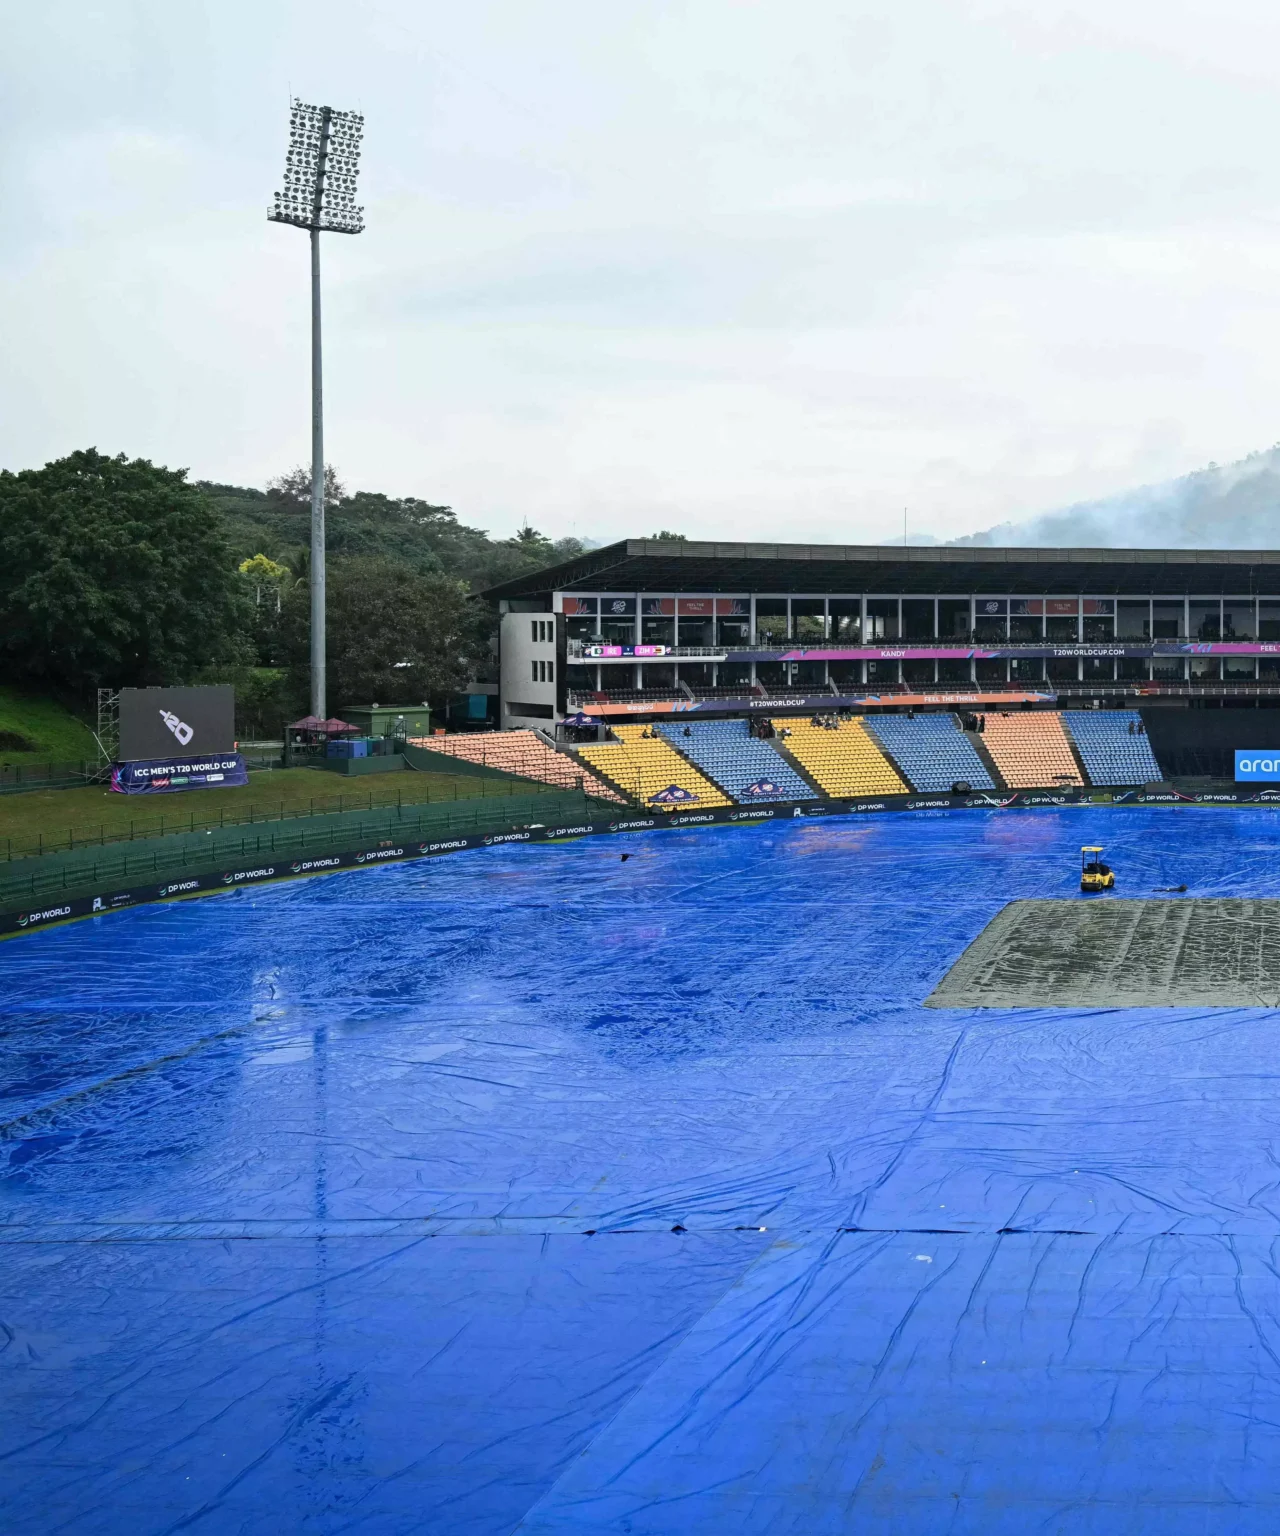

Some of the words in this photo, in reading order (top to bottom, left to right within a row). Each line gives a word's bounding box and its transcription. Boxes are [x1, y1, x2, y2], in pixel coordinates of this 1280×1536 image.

[150, 767, 175, 775] MEN'S
[191, 763, 220, 772] WORLD
[567, 826, 593, 834] WORLD
[504, 832, 530, 840] WORLD
[440, 840, 467, 848] WORLD
[377, 849, 403, 858] WORLD
[313, 858, 340, 868] WORLD
[234, 872, 245, 881] DP
[246, 868, 274, 878] WORLD
[168, 884, 178, 893] DP
[30, 914, 41, 922] DP
[42, 906, 71, 918] WORLD
